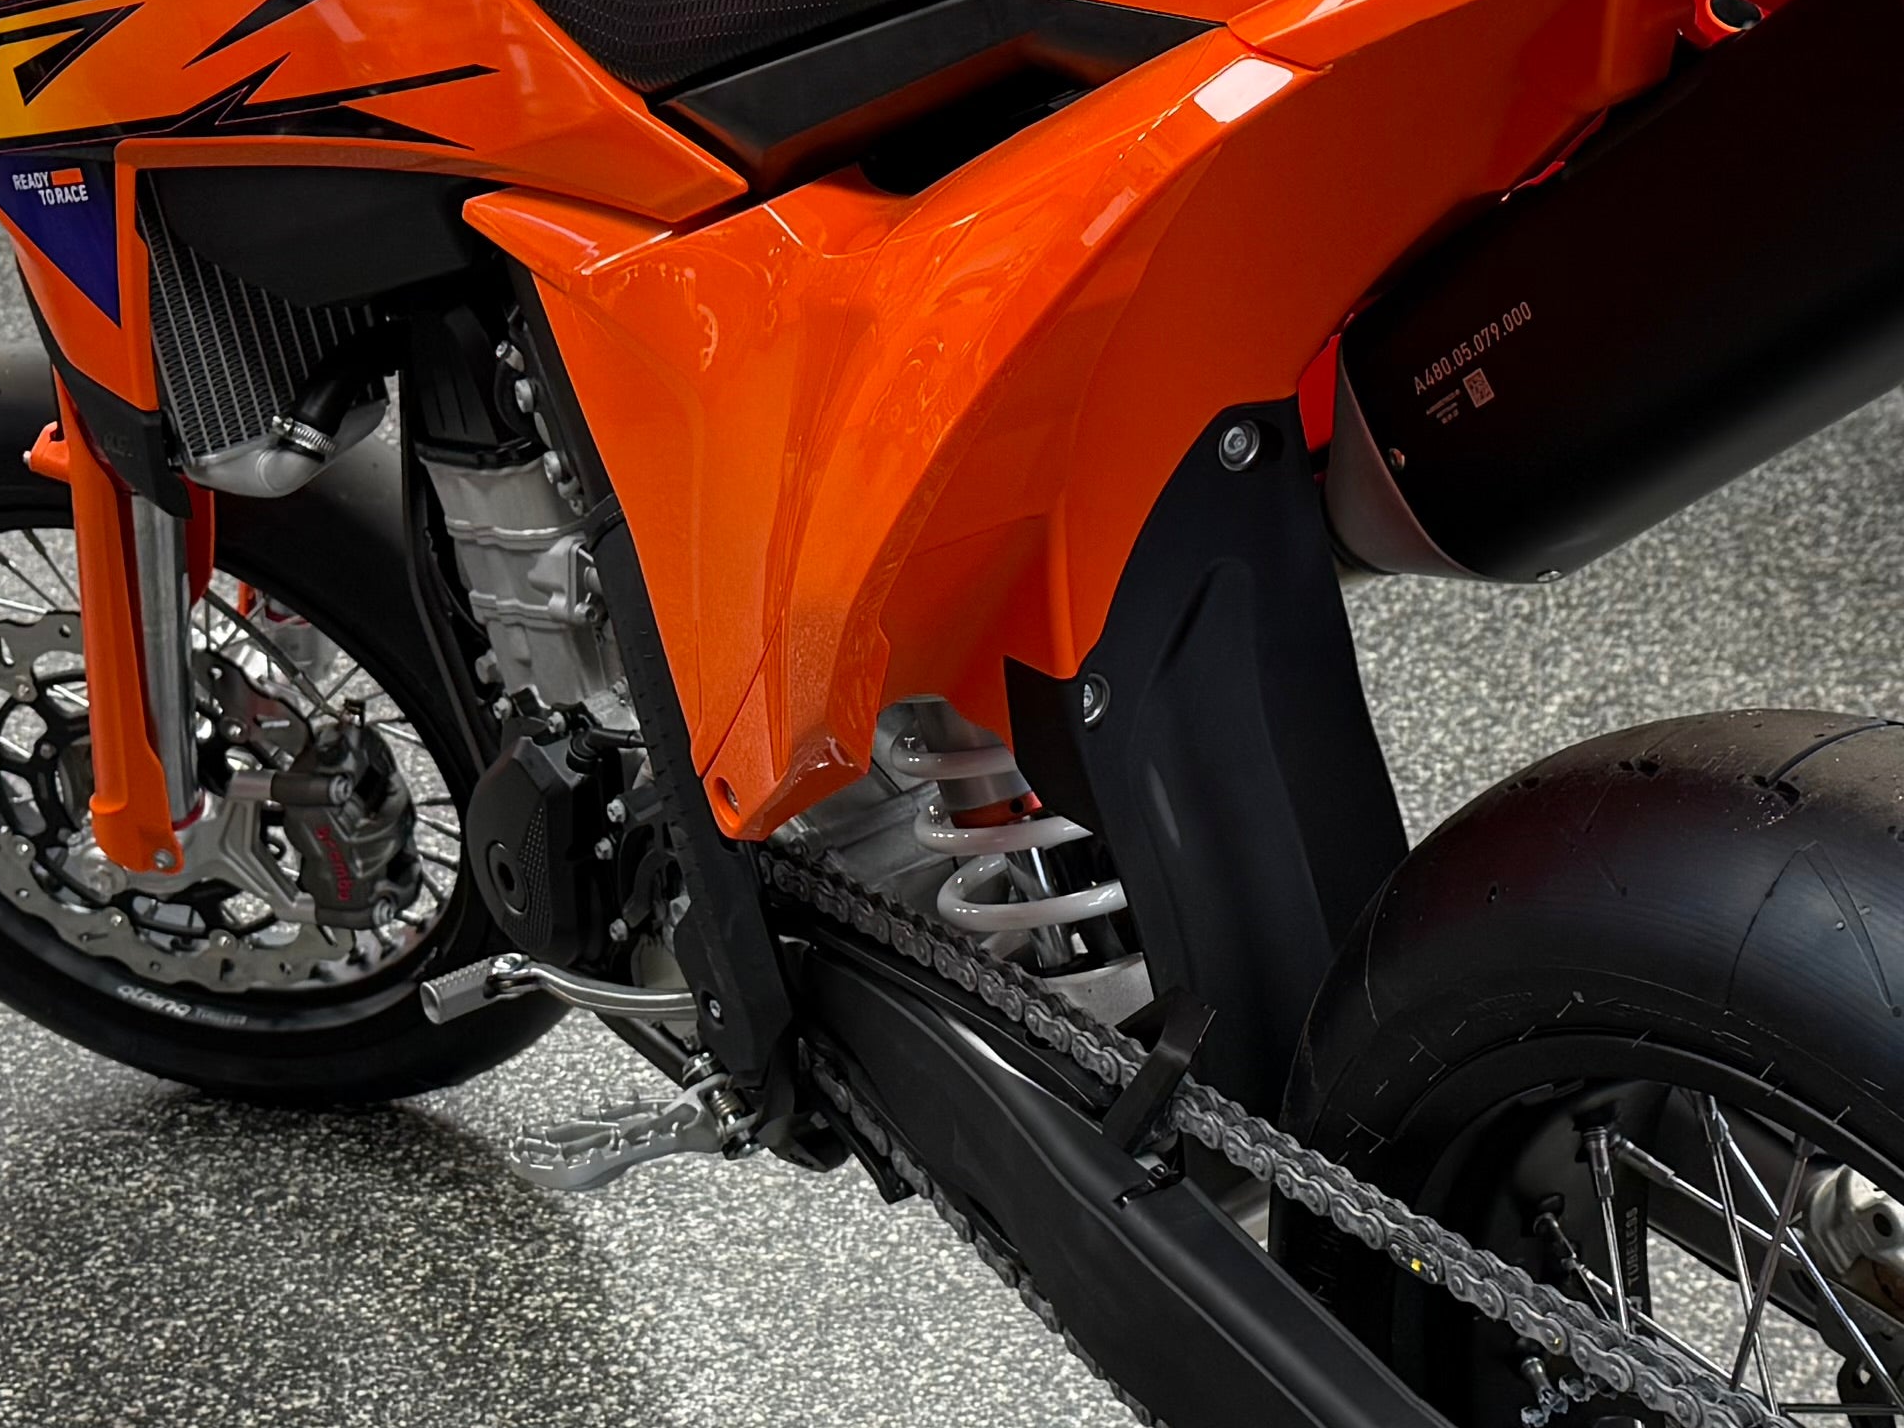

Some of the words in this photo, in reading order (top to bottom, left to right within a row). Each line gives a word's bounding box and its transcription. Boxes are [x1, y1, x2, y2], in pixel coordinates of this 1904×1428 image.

[11, 171, 49, 191] READY
[38, 188, 56, 206] TO
[53, 183, 89, 205] RACE
[1413, 300, 1533, 396] A480.05.079.000
[1625, 1206, 1641, 1288] TUBELESS
